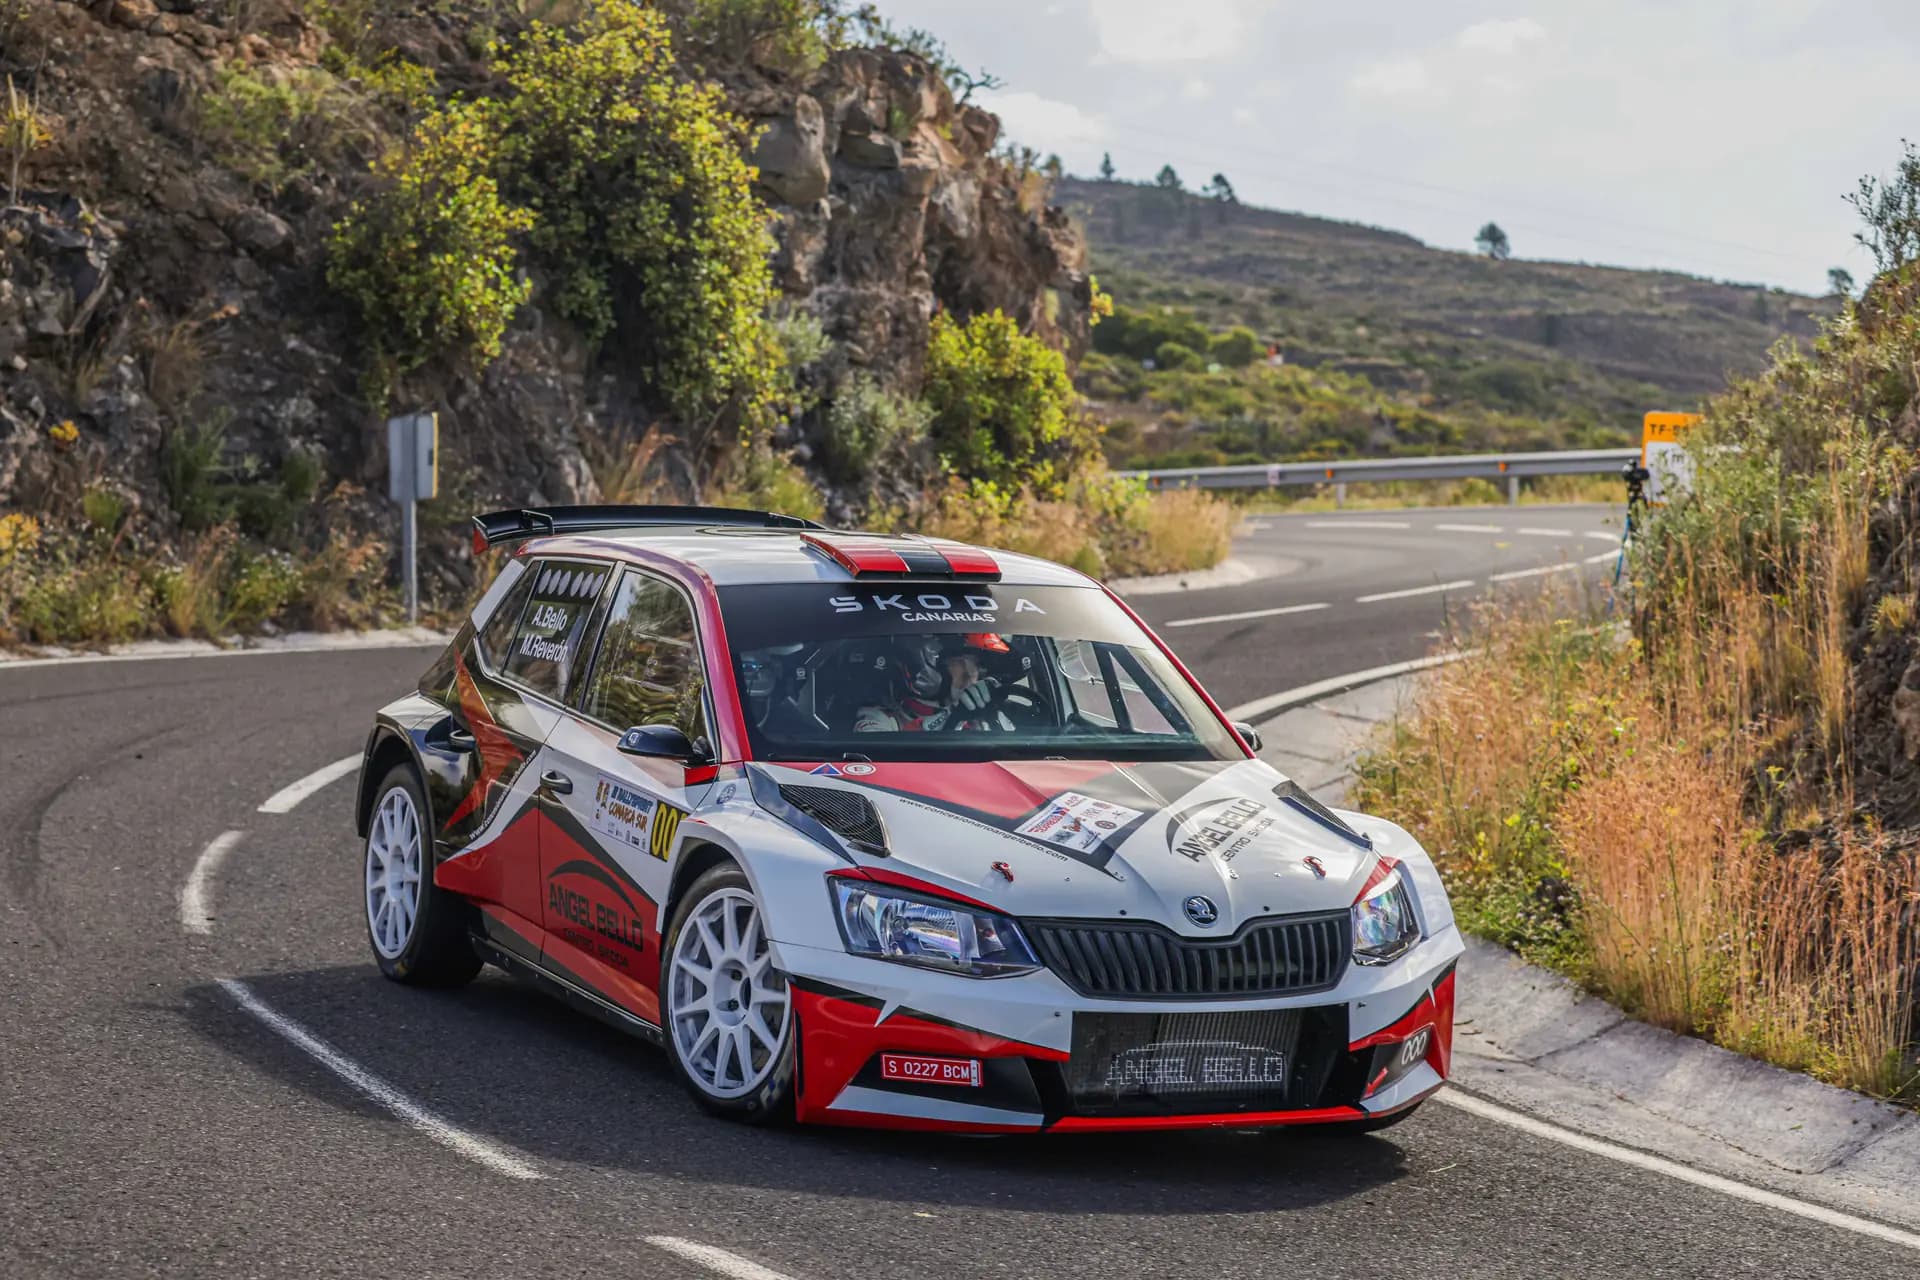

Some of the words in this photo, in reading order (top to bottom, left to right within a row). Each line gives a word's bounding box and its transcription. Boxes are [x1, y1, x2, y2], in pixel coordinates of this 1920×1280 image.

[531, 603, 568, 631] A.Bello
[829, 594, 1047, 614] SKODA
[902, 612, 996, 623] CANARIAS
[519, 632, 569, 663] M.Reverón
[899, 798, 1069, 862] www.concesionarioangelbello.com
[1175, 826, 1234, 863] ANGEL
[1212, 798, 1267, 831] BELLO
[1219, 836, 1252, 862] CENTRO
[548, 882, 596, 931] ANGEL
[596, 902, 643, 952] BELLO
[888, 1060, 898, 1073] S
[904, 1061, 939, 1077] 0227
[943, 1064, 970, 1079] BCM
[1104, 1057, 1196, 1086] ANGEL
[1203, 1056, 1284, 1083] BELLO
